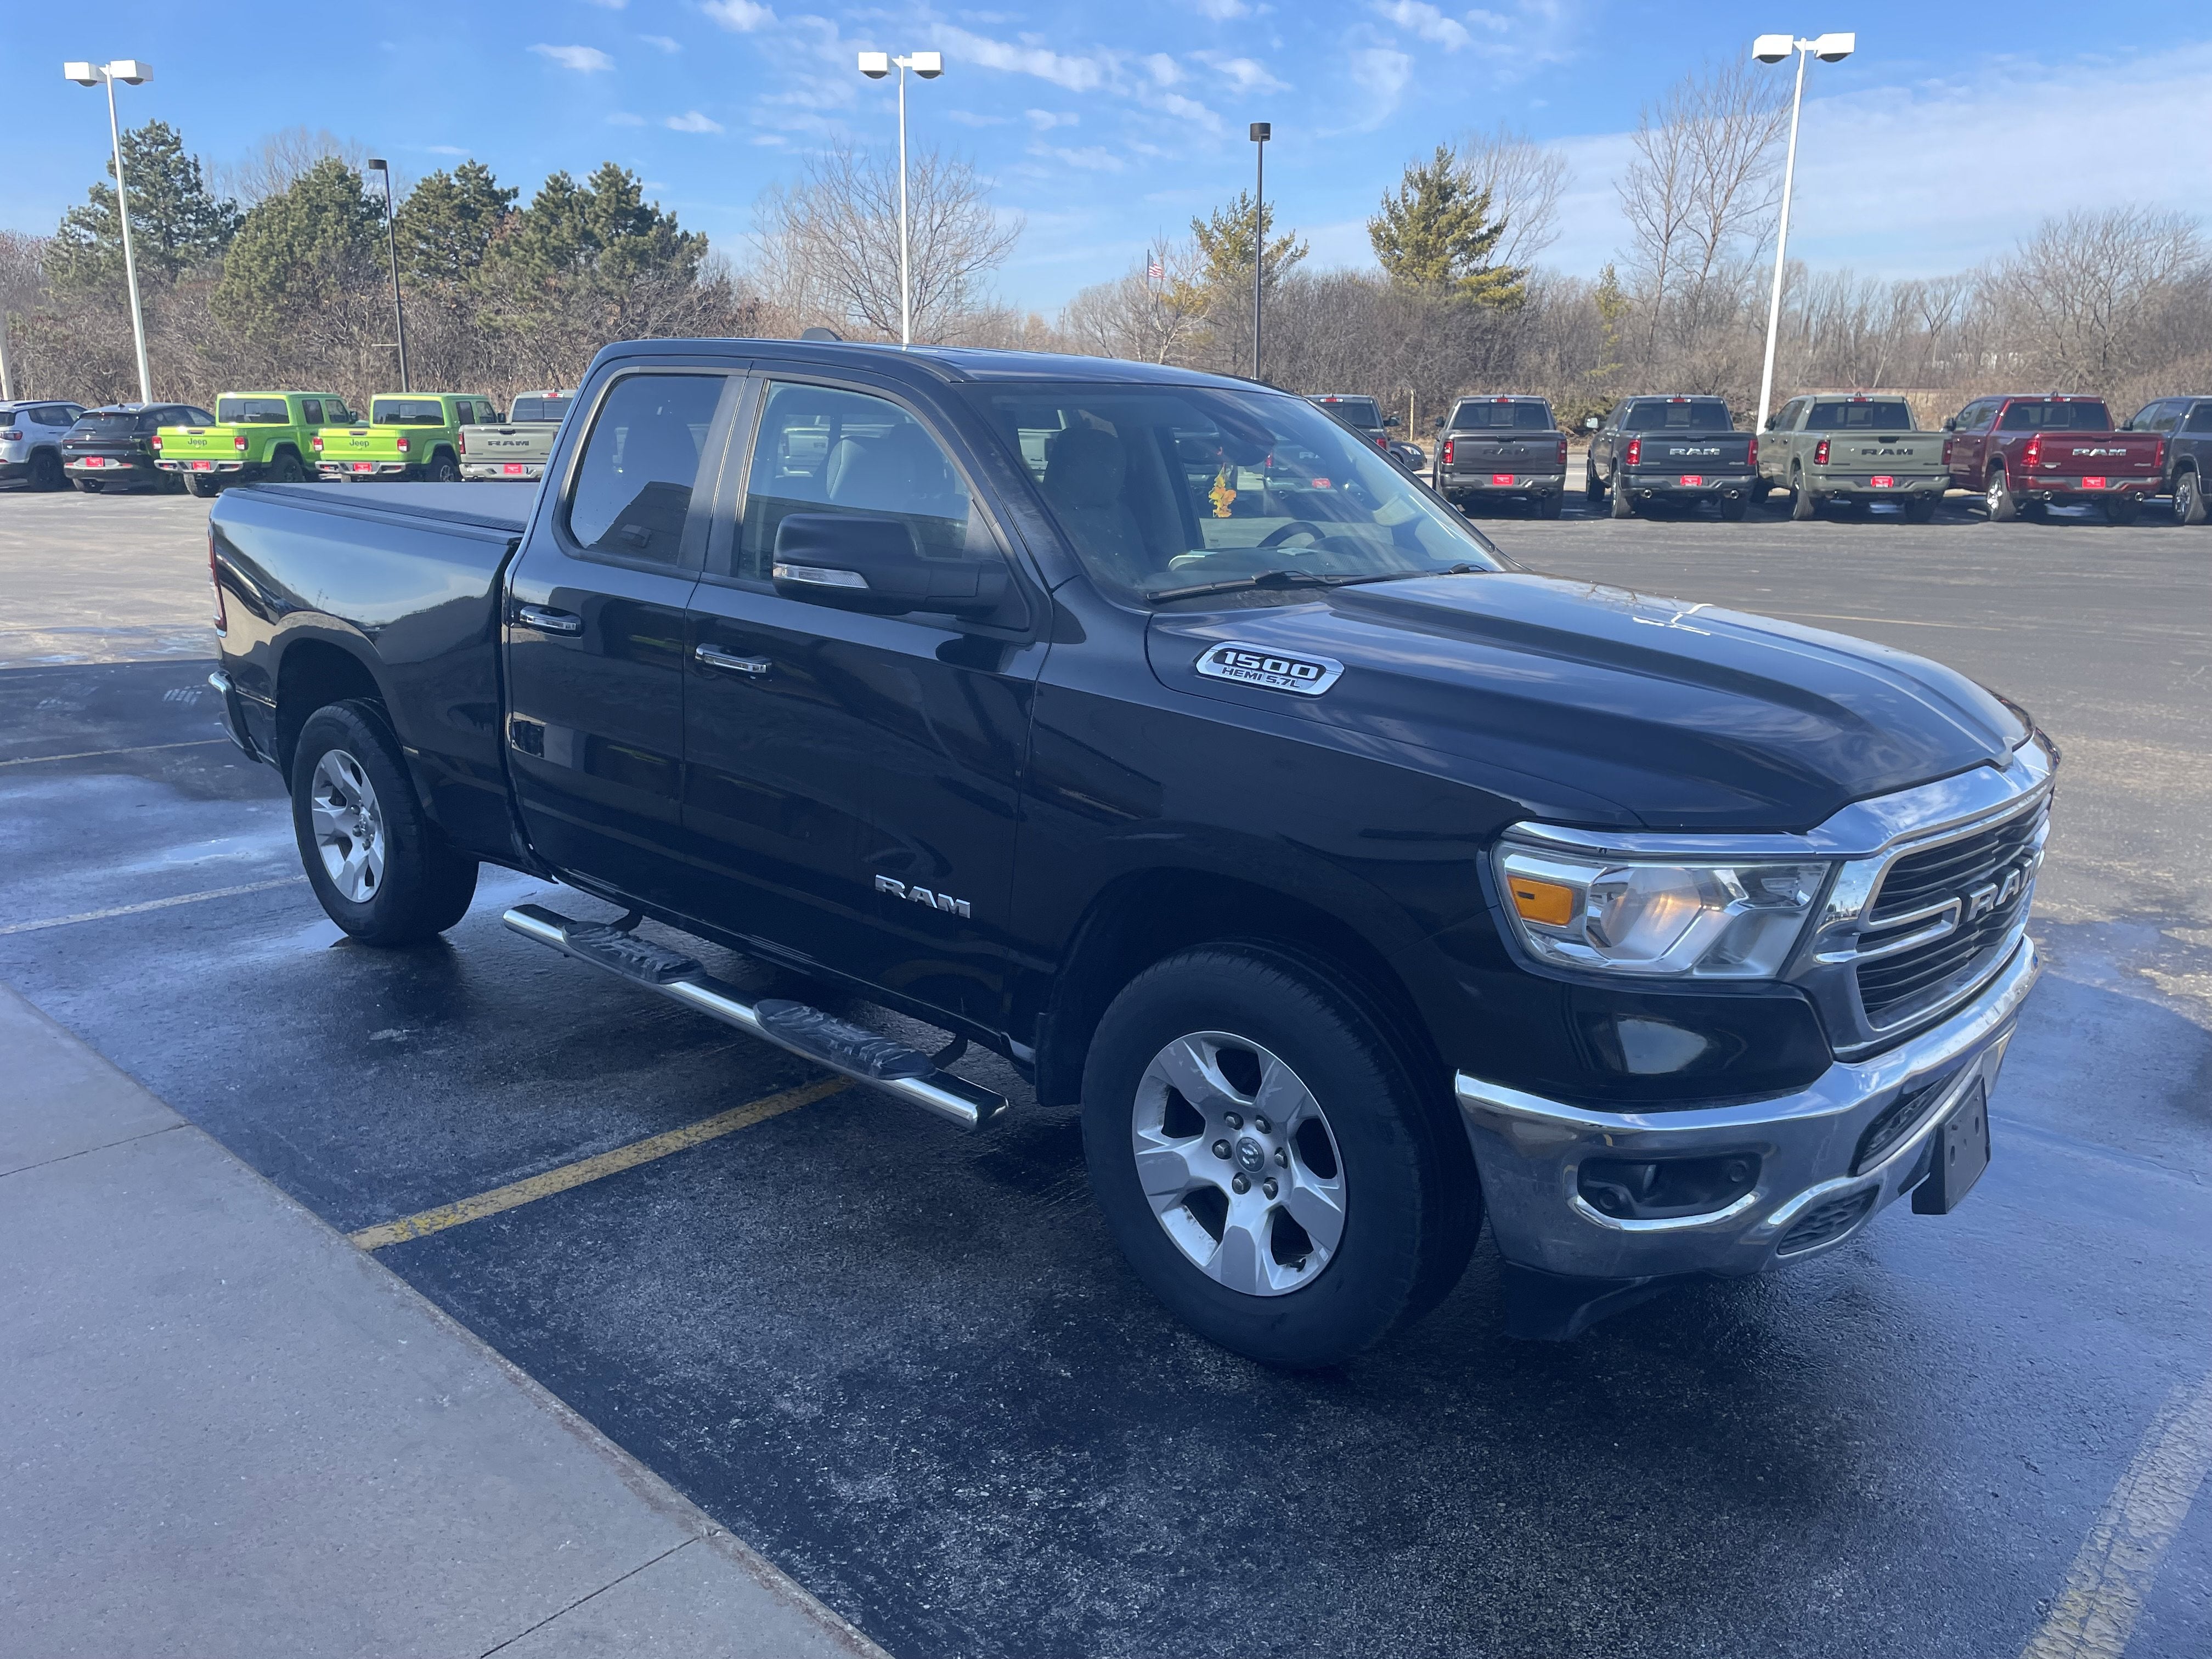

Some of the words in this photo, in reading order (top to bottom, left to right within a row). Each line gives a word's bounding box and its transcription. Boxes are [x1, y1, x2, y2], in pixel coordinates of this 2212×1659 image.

[188, 437, 207, 446] Jeep
[348, 438, 369, 448] Jeep
[2072, 448, 2127, 456] RAM
[1224, 651, 1319, 680] 1500
[1221, 667, 1261, 681] HEMI
[1265, 675, 1301, 688] 5.7L
[874, 874, 970, 919] RAM
